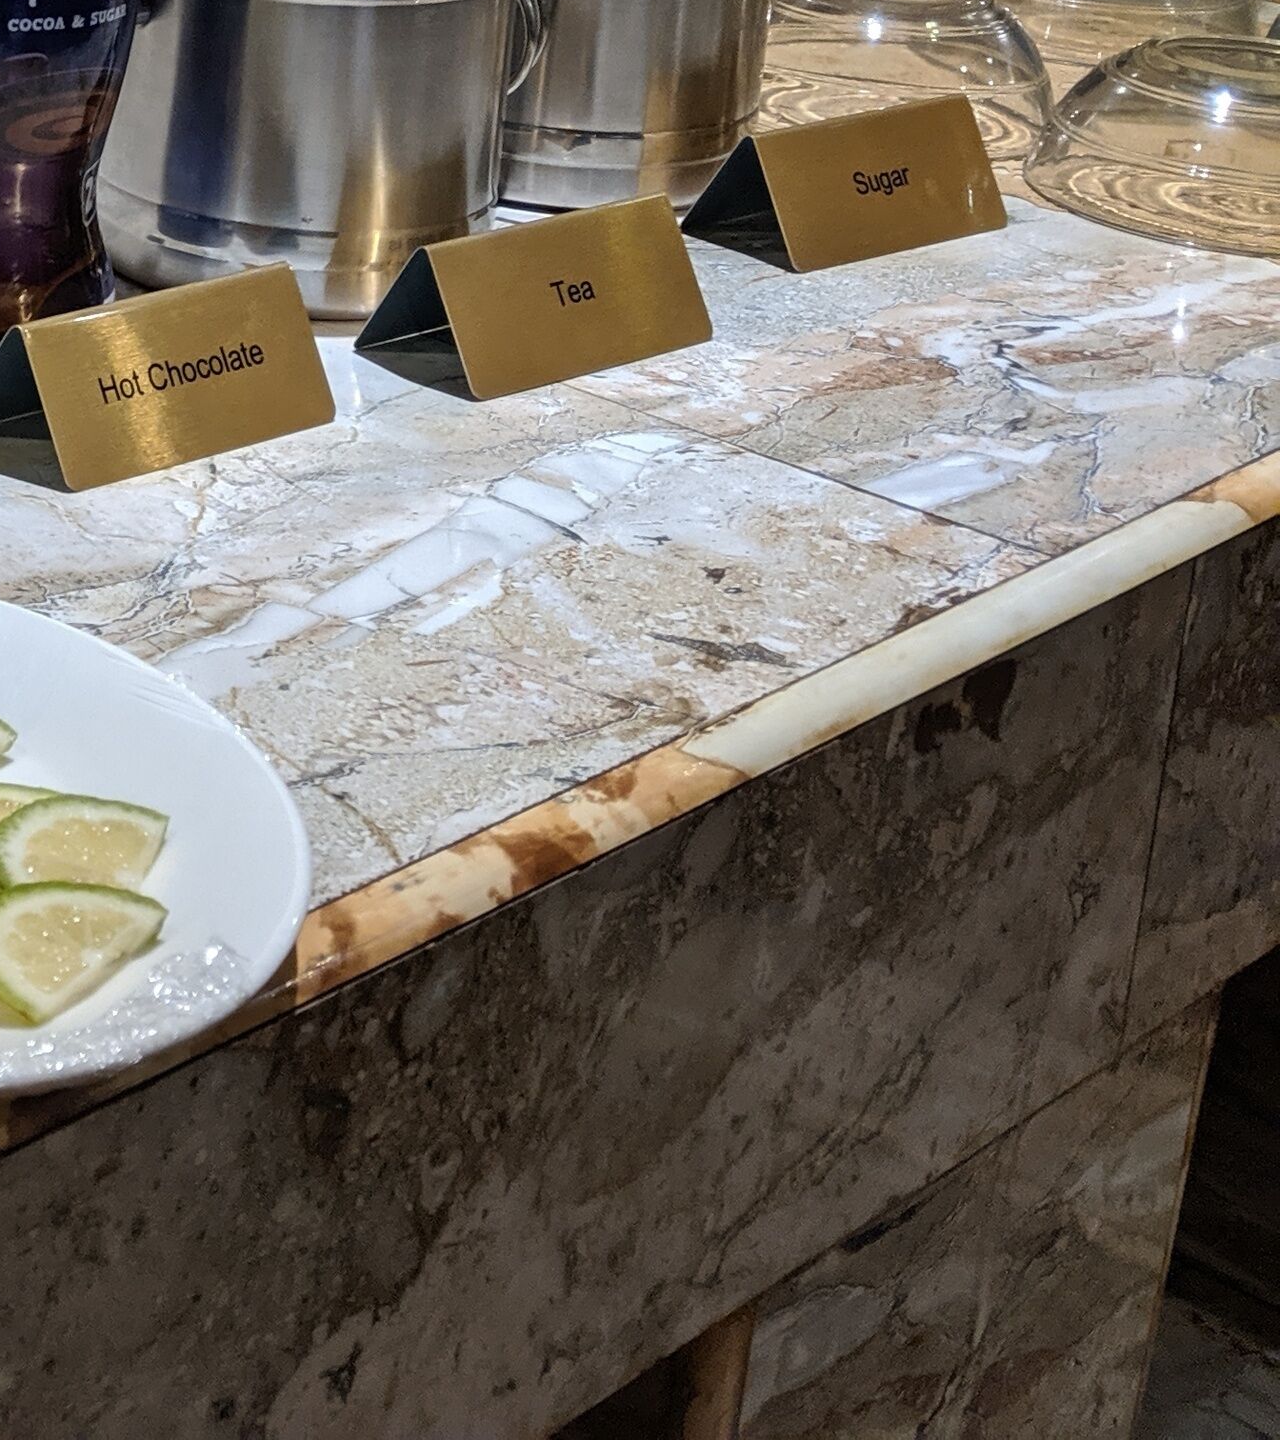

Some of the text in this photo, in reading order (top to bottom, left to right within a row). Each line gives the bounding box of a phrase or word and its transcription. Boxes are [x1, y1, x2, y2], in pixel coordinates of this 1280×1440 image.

[7, 4, 127, 32] COCOA & SUGAR
[852, 167, 910, 195] Sugar
[549, 280, 596, 308] Tea
[98, 342, 265, 404] Hot Chocolate
